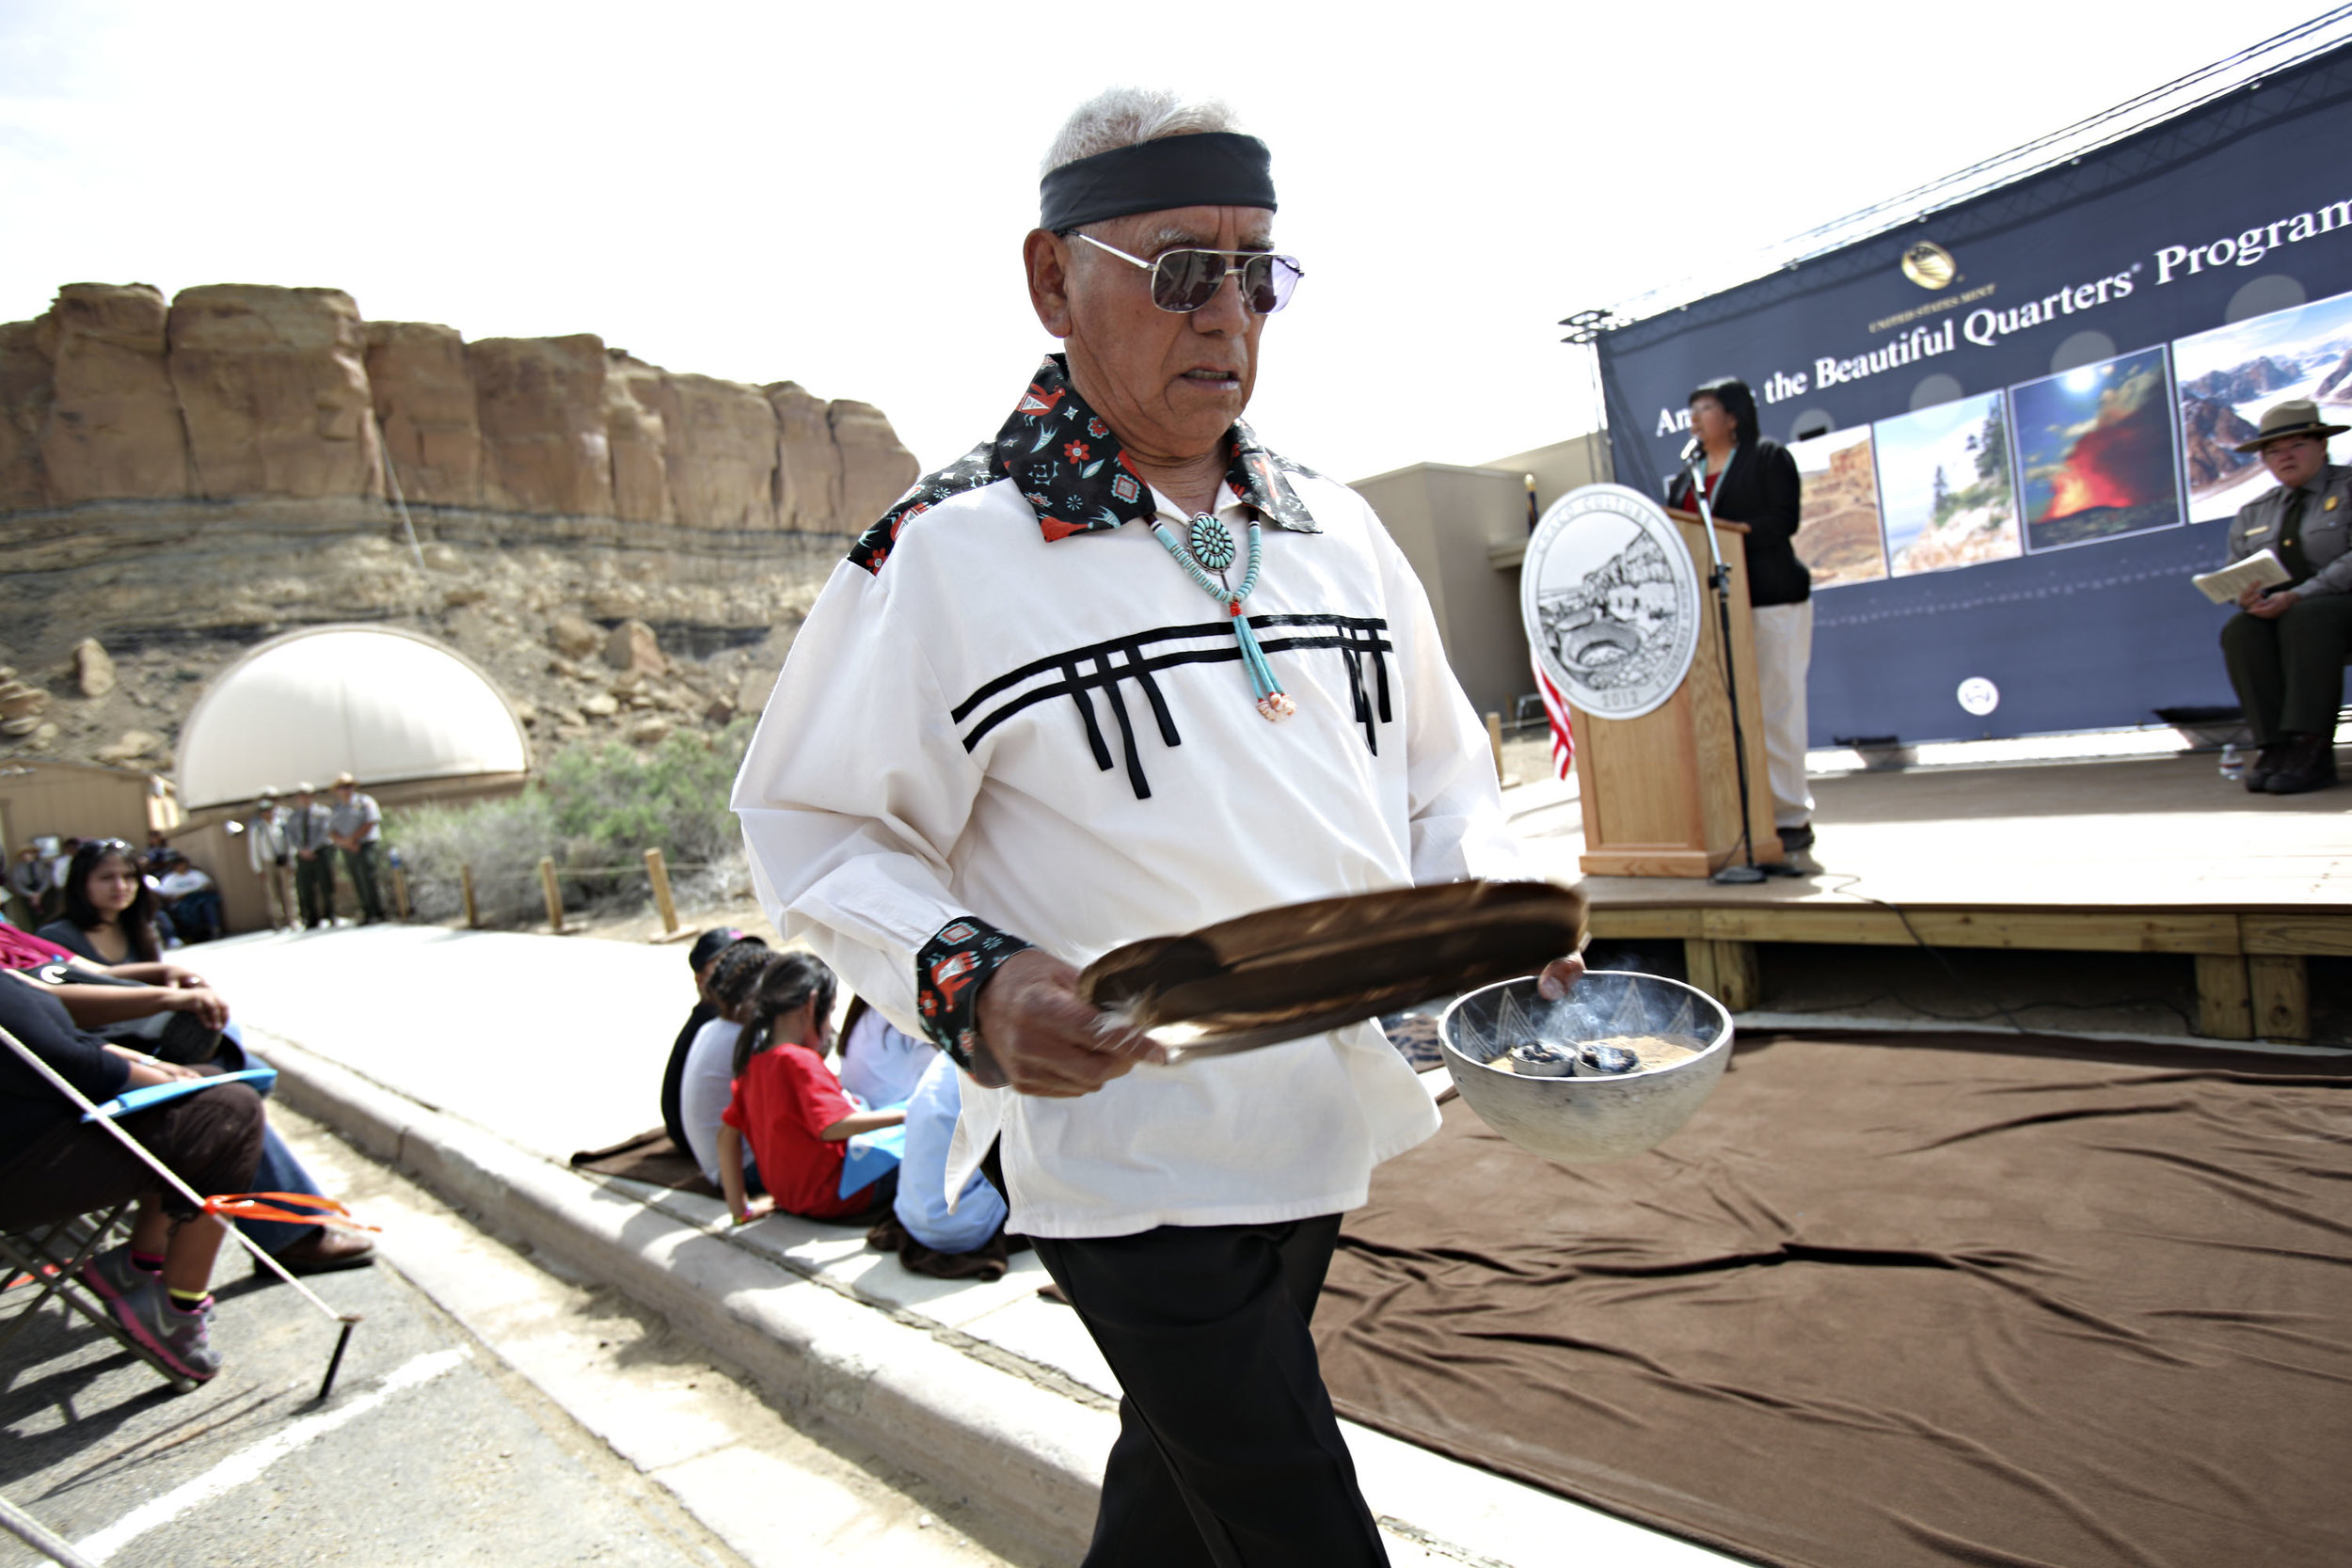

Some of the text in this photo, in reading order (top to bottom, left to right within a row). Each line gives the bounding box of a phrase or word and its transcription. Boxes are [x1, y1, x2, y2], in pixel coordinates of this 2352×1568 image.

[1764, 371, 1807, 404] the
[1814, 318, 1955, 390] Beautiful
[2153, 198, 2352, 285] Program
